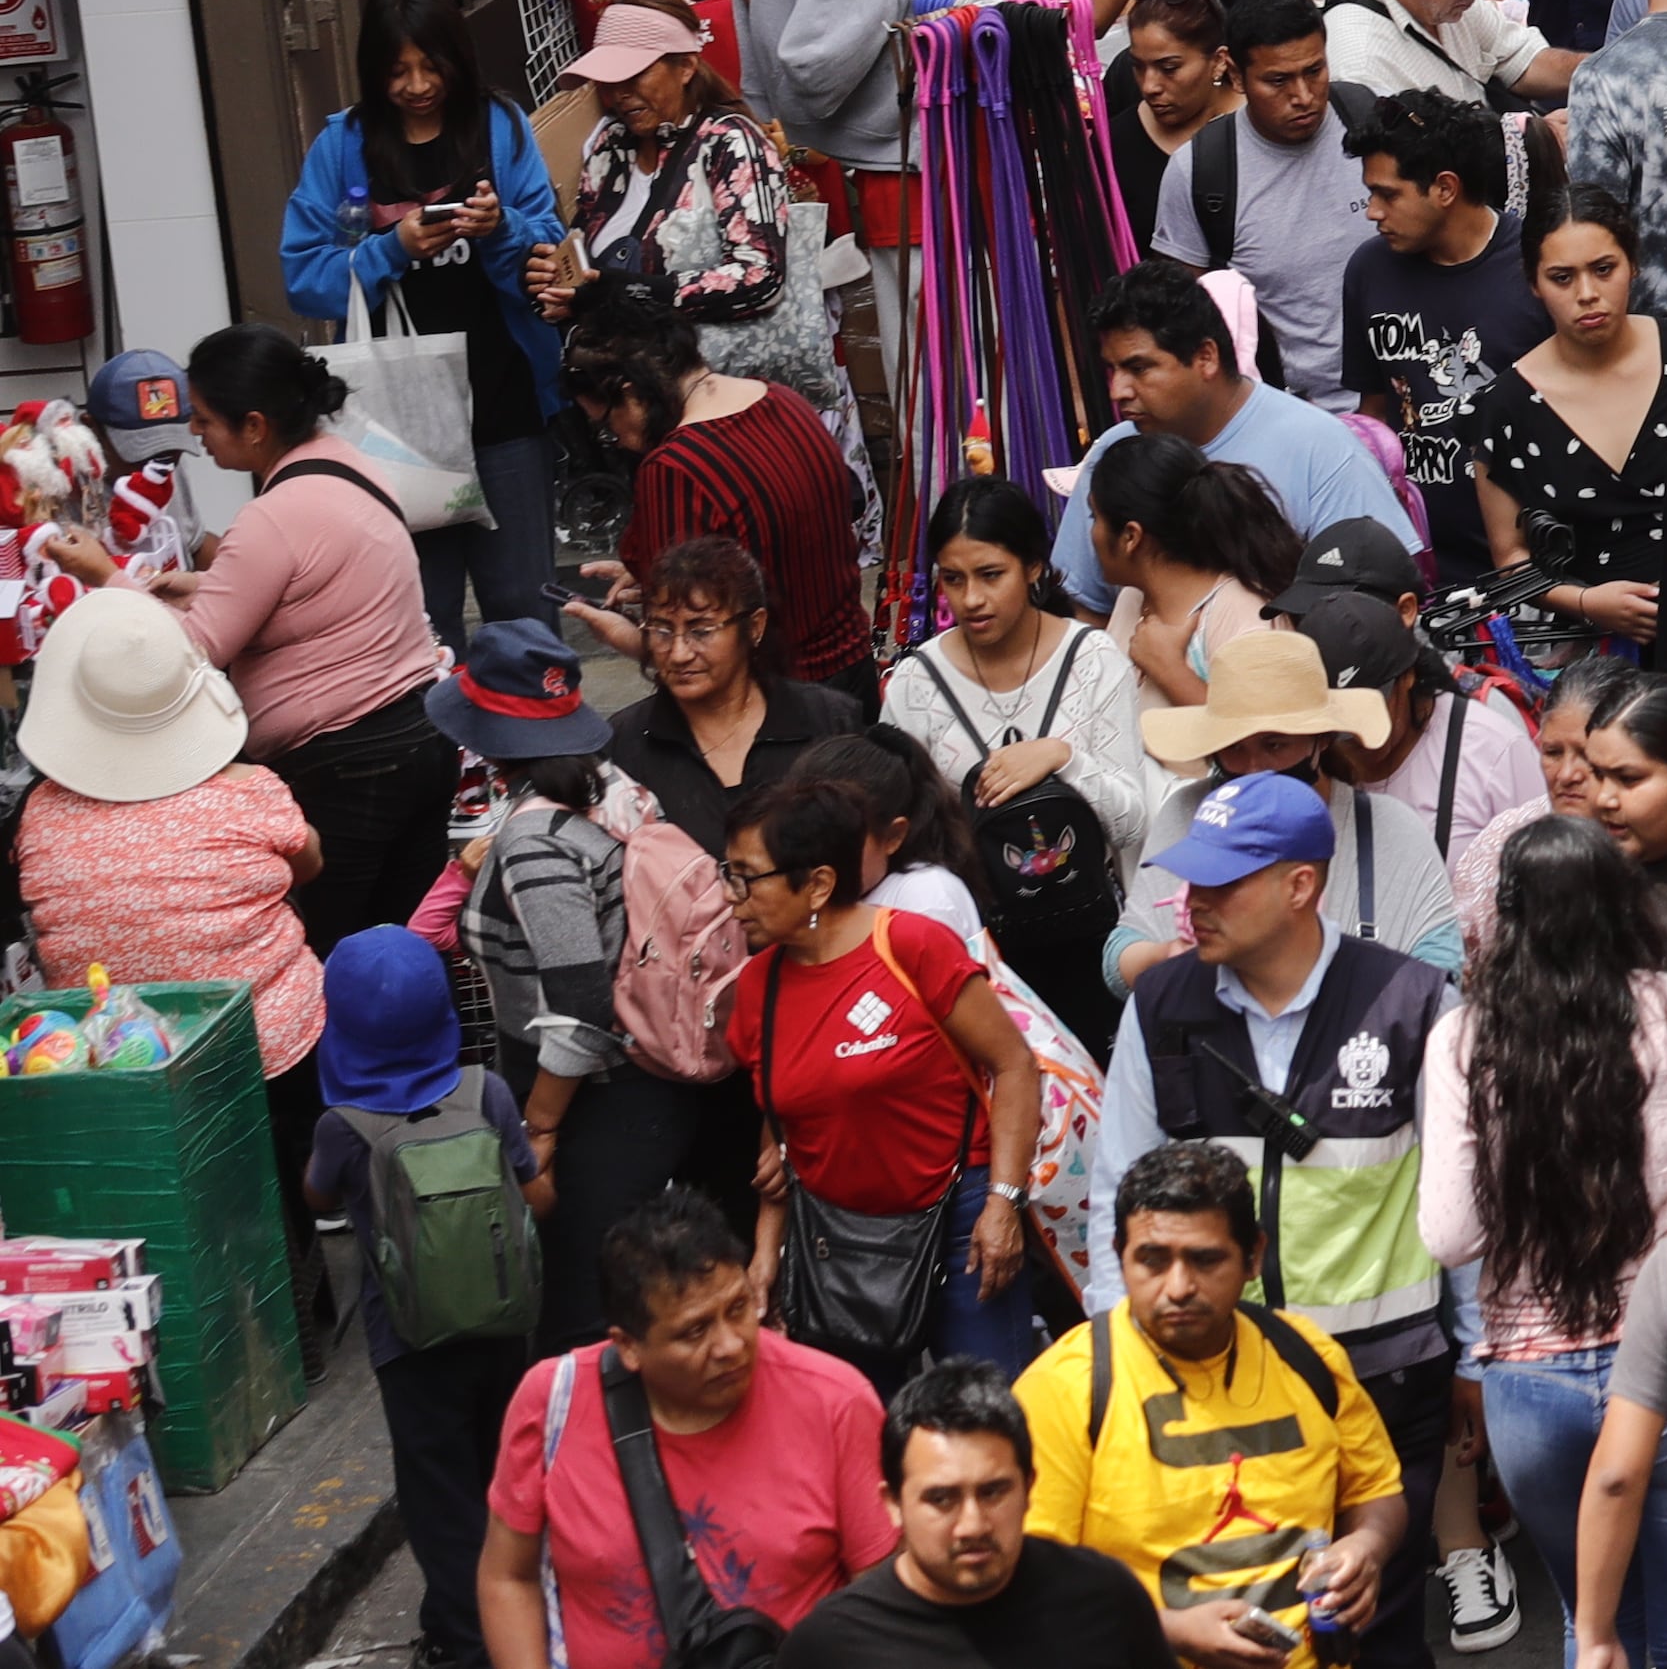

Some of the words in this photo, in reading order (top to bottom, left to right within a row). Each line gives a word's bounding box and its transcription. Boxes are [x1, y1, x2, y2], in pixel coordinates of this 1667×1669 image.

[1368, 311, 1427, 362] TOM
[1397, 430, 1462, 485] ERRY
[834, 1032, 899, 1059] Columbia
[1331, 1093, 1393, 1109] LIMA
